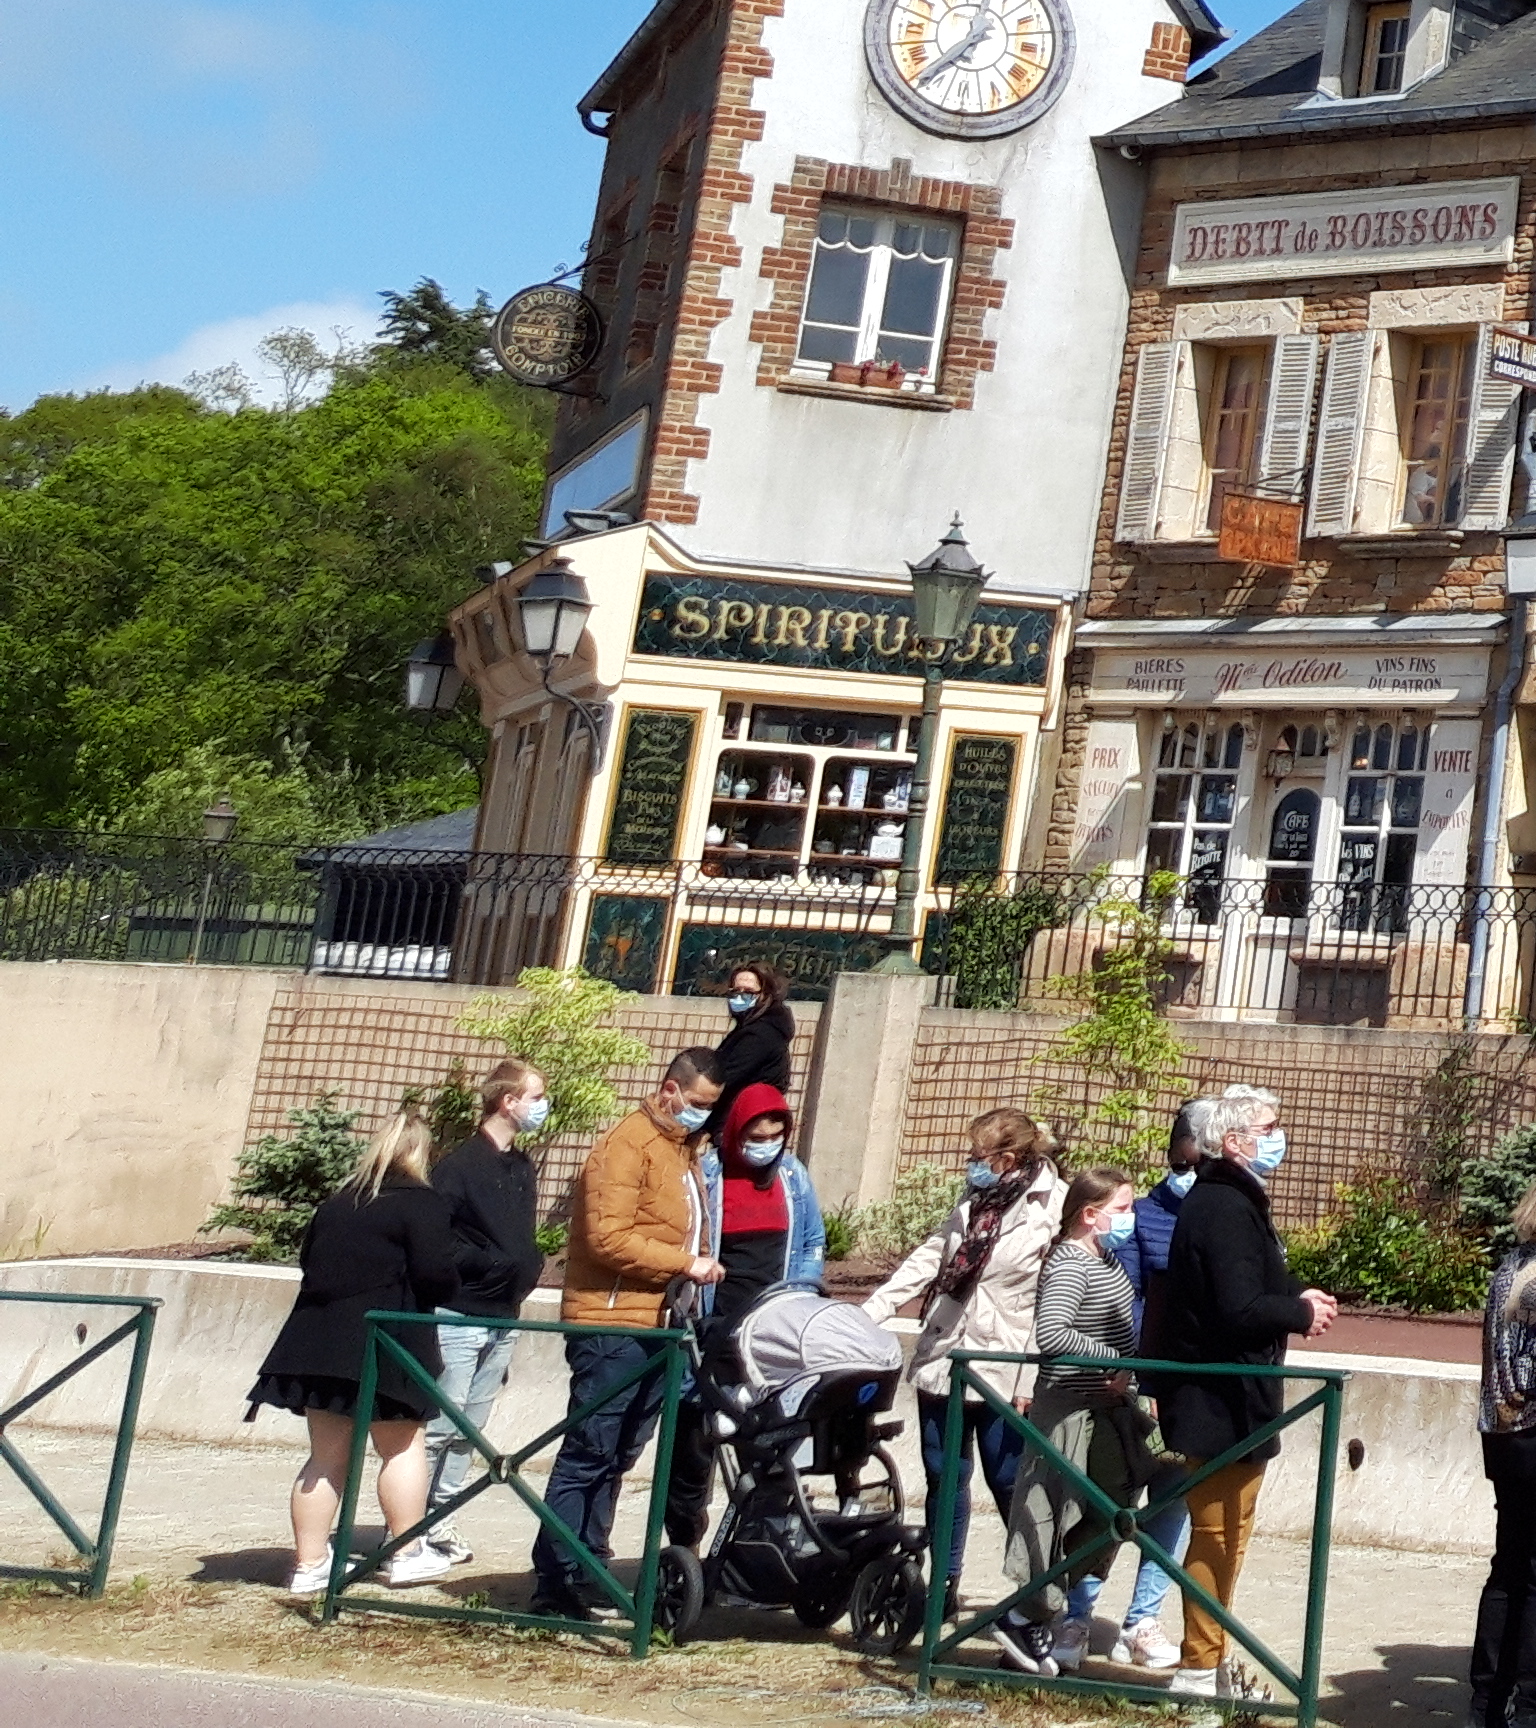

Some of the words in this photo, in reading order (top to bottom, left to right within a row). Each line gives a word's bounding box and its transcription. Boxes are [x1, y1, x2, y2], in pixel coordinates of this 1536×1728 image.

[1186, 220, 1290, 262] DEBIT
[1294, 221, 1319, 254] de
[1325, 201, 1499, 252] BOISSONS
[1494, 333, 1521, 361] POSTE
[505, 344, 586, 376] COMPTOIR
[1375, 658, 1404, 674] VINS
[1409, 657, 1437, 673] FINS
[1367, 675, 1388, 690] DU
[1391, 676, 1443, 693] PATRON
[1091, 747, 1121, 769] PRIX
[1433, 750, 1473, 773] VENTE
